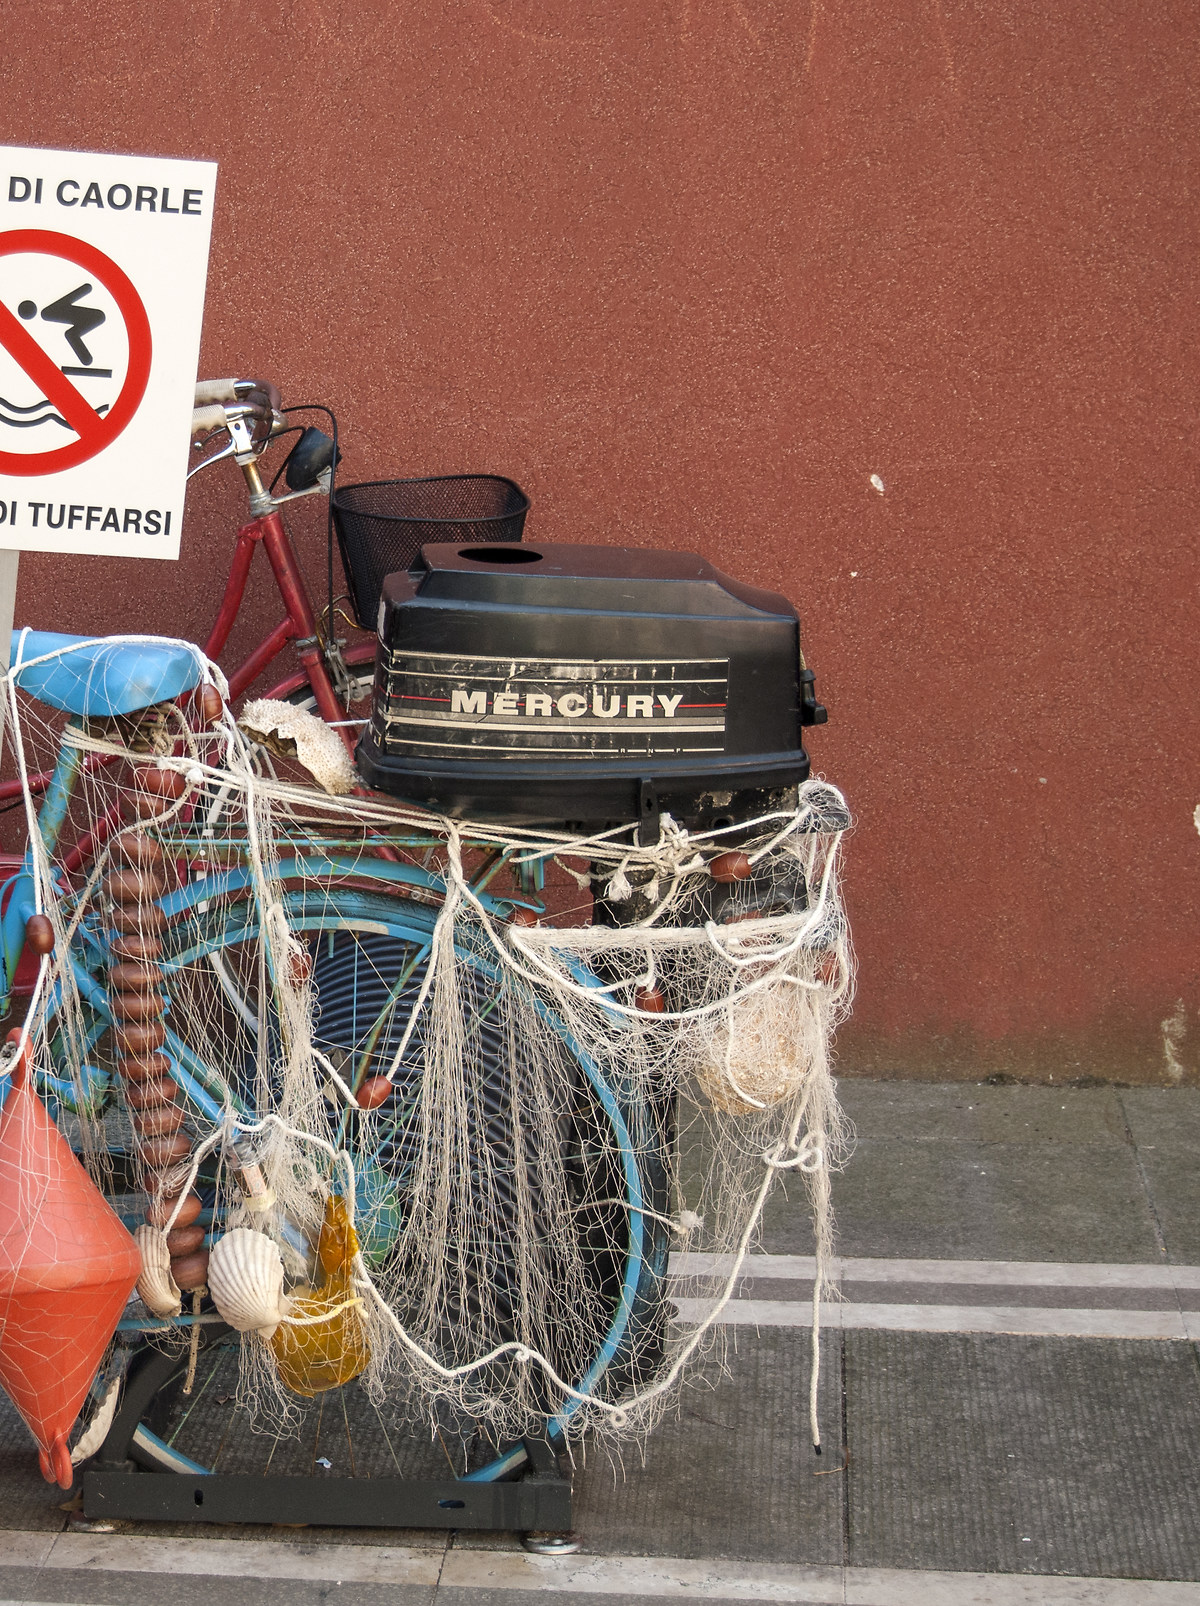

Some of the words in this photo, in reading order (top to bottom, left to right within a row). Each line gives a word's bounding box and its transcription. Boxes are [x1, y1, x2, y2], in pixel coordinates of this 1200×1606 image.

[8, 176, 44, 204] DI
[56, 179, 204, 216] CAORLE
[27, 501, 172, 536] TUFFARSI
[451, 690, 684, 718] MERCURY
